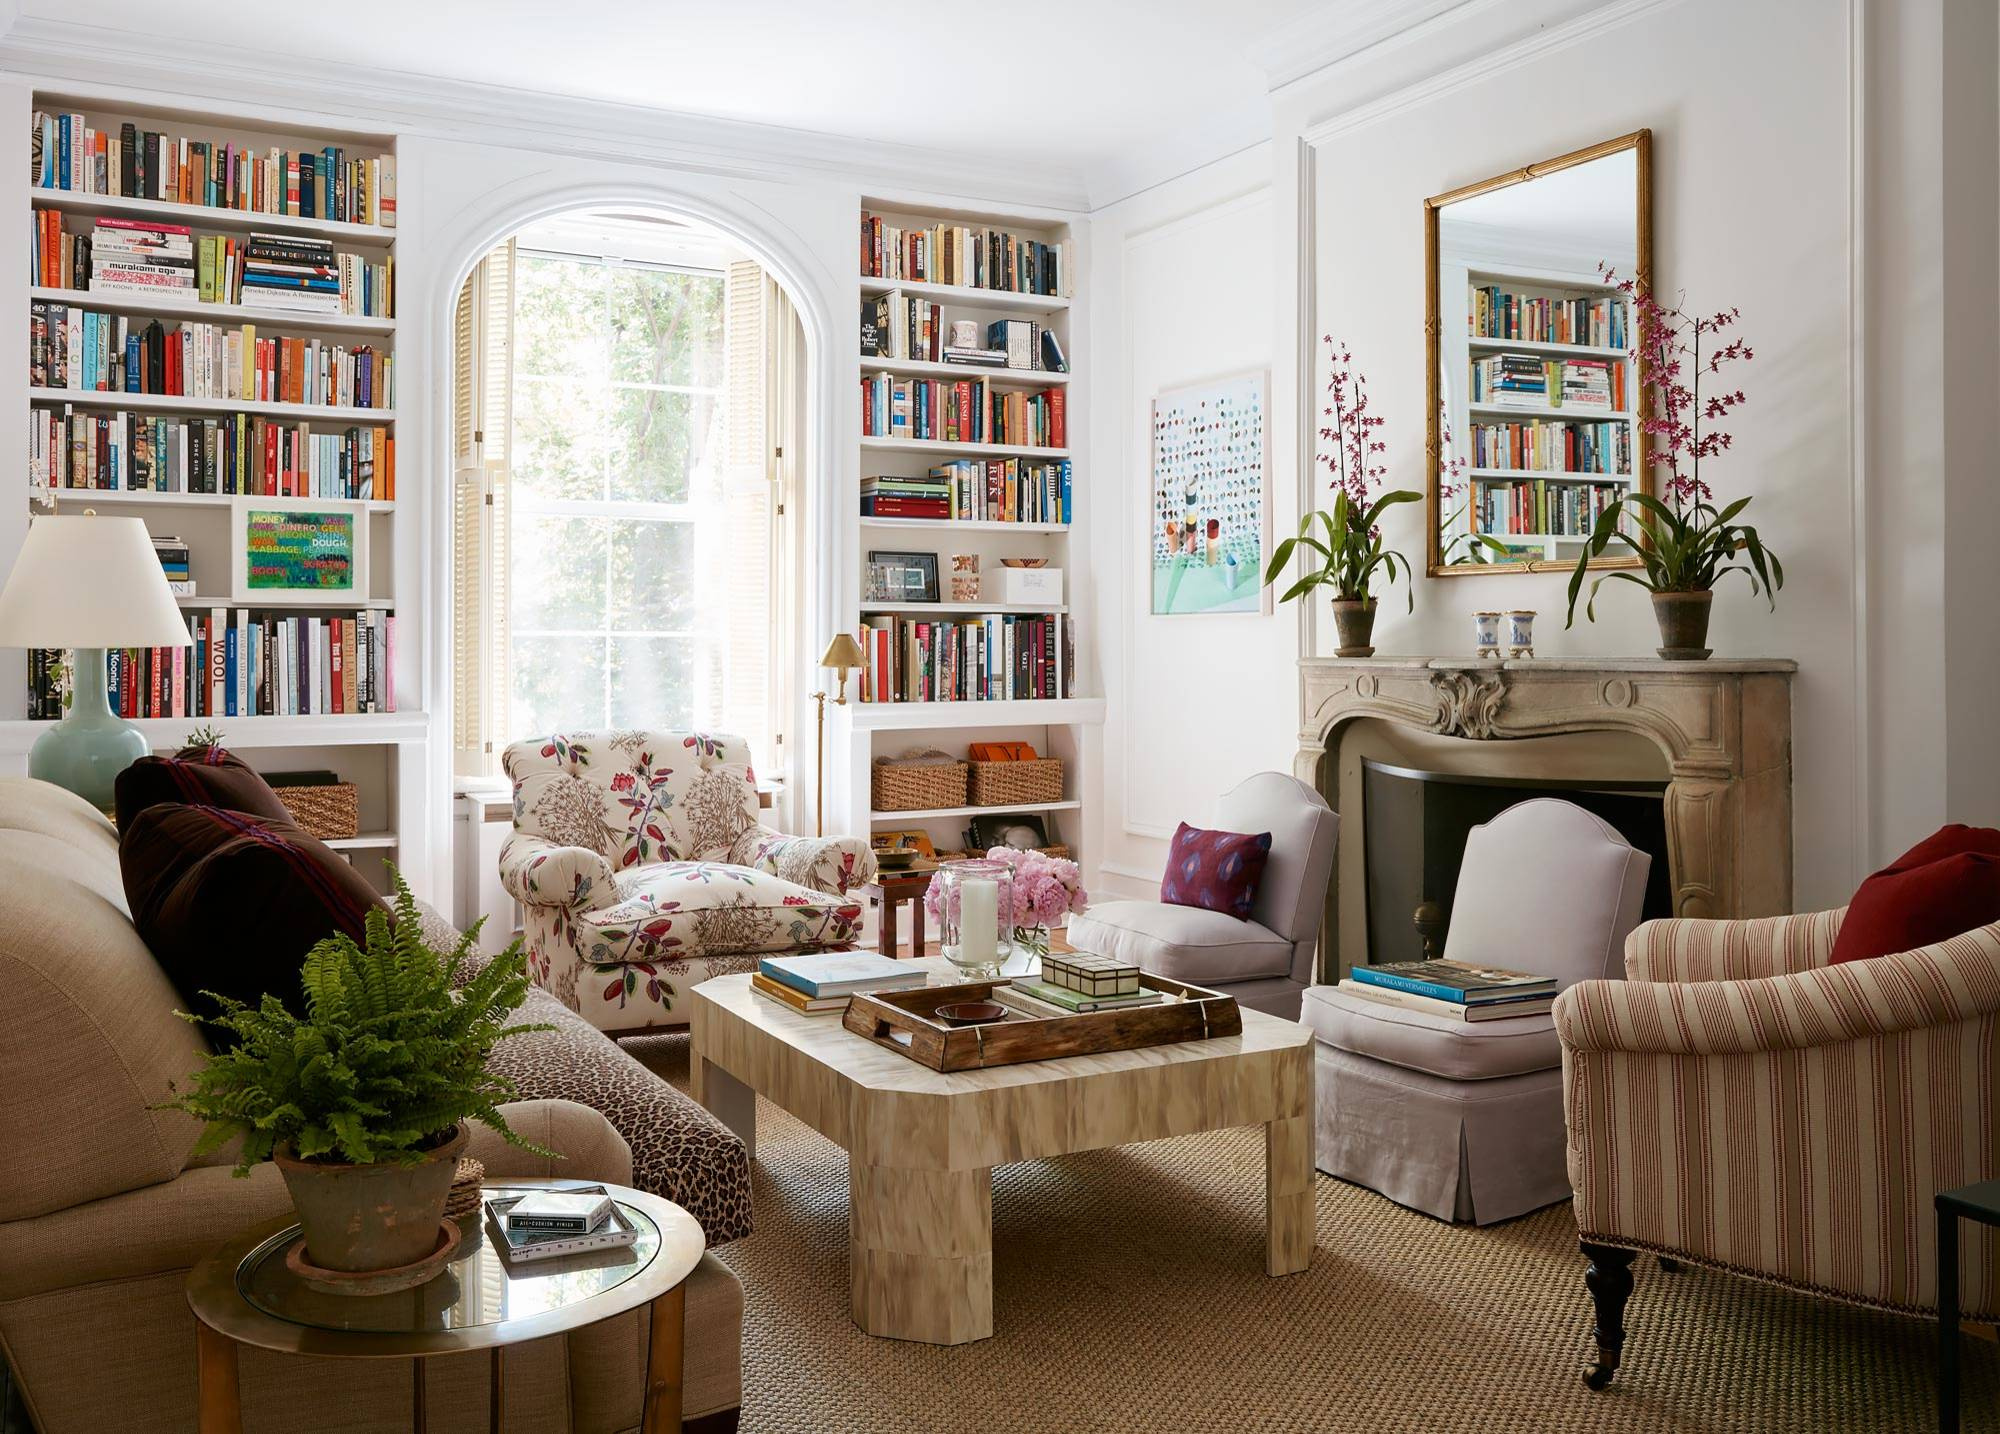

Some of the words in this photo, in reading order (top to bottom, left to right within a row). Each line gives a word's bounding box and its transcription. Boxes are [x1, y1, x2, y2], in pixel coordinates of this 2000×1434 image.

[109, 263, 155, 272] murakami
[989, 466, 998, 496] RFK
[345, 623, 354, 657] RALPH
[109, 654, 119, 692] Kooning
[213, 640, 225, 688] WOOL
[346, 661, 354, 702] LAUREN
[1375, 976, 1403, 988] MURAKAMI
[1404, 982, 1438, 994] VERSAILLES
